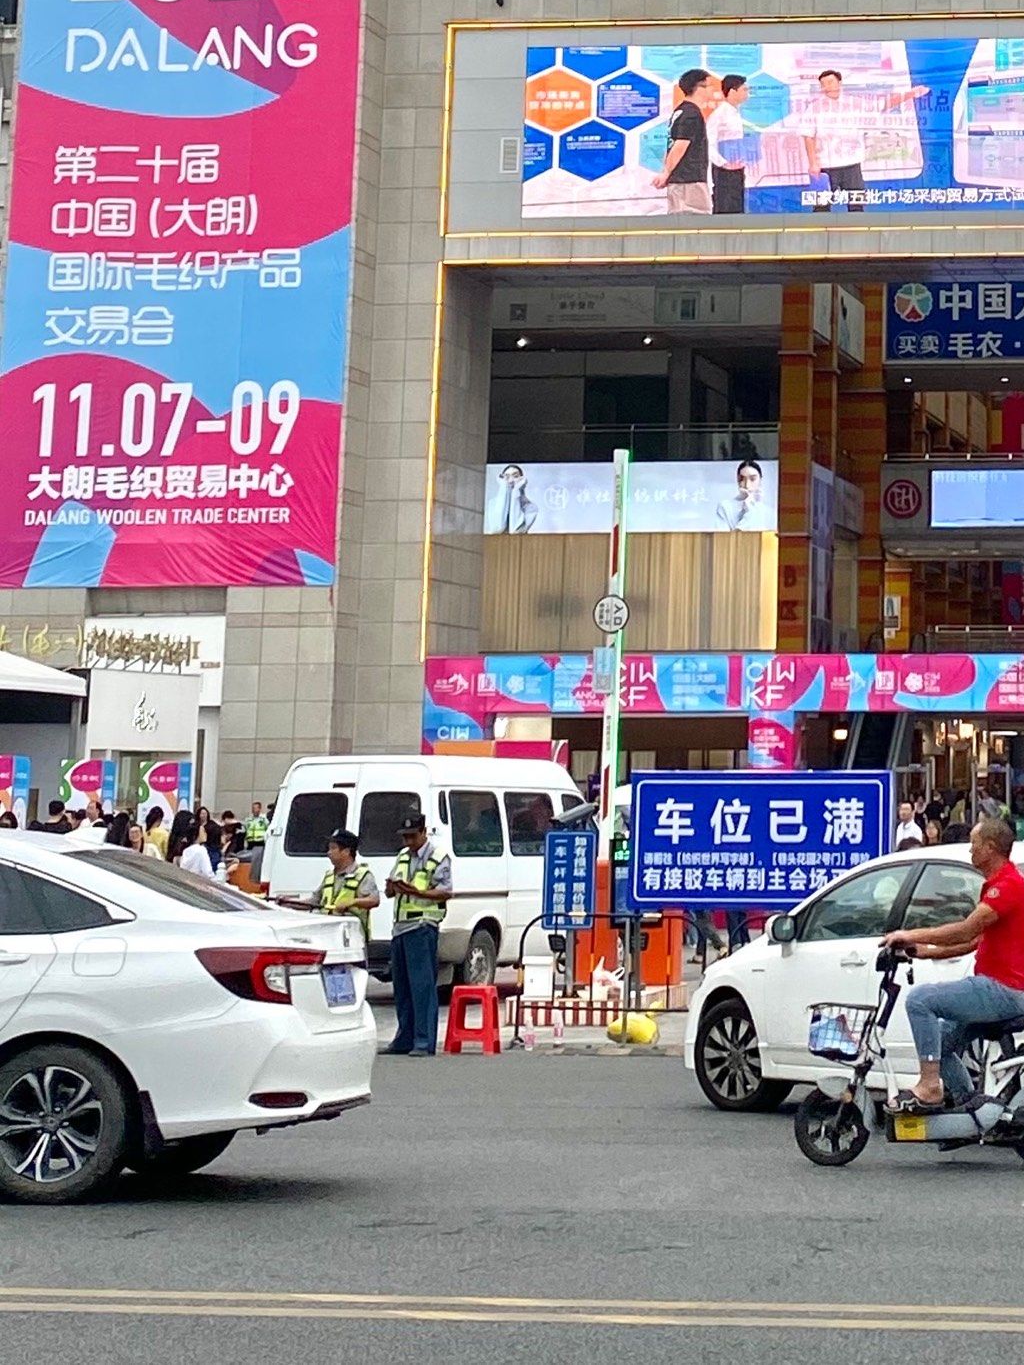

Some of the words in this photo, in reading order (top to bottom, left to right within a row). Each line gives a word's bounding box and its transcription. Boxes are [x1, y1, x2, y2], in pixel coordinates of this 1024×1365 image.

[65, 23, 318, 72] DALANG
[52, 144, 220, 185] 第二十届
[48, 248, 302, 292] 国际毛织产品
[43, 305, 174, 346] 交易会
[897, 331, 940, 354] 买卖
[27, 463, 294, 501] 大朗毛织贸易中心
[24, 508, 91, 527] DALANG
[96, 508, 167, 526] WOOLEN
[172, 507, 223, 525] TRADE
[226, 506, 290, 524] CENTER
[746, 661, 795, 683] CIW
[746, 685, 785, 707] KF
[654, 797, 865, 845] 车位已满
